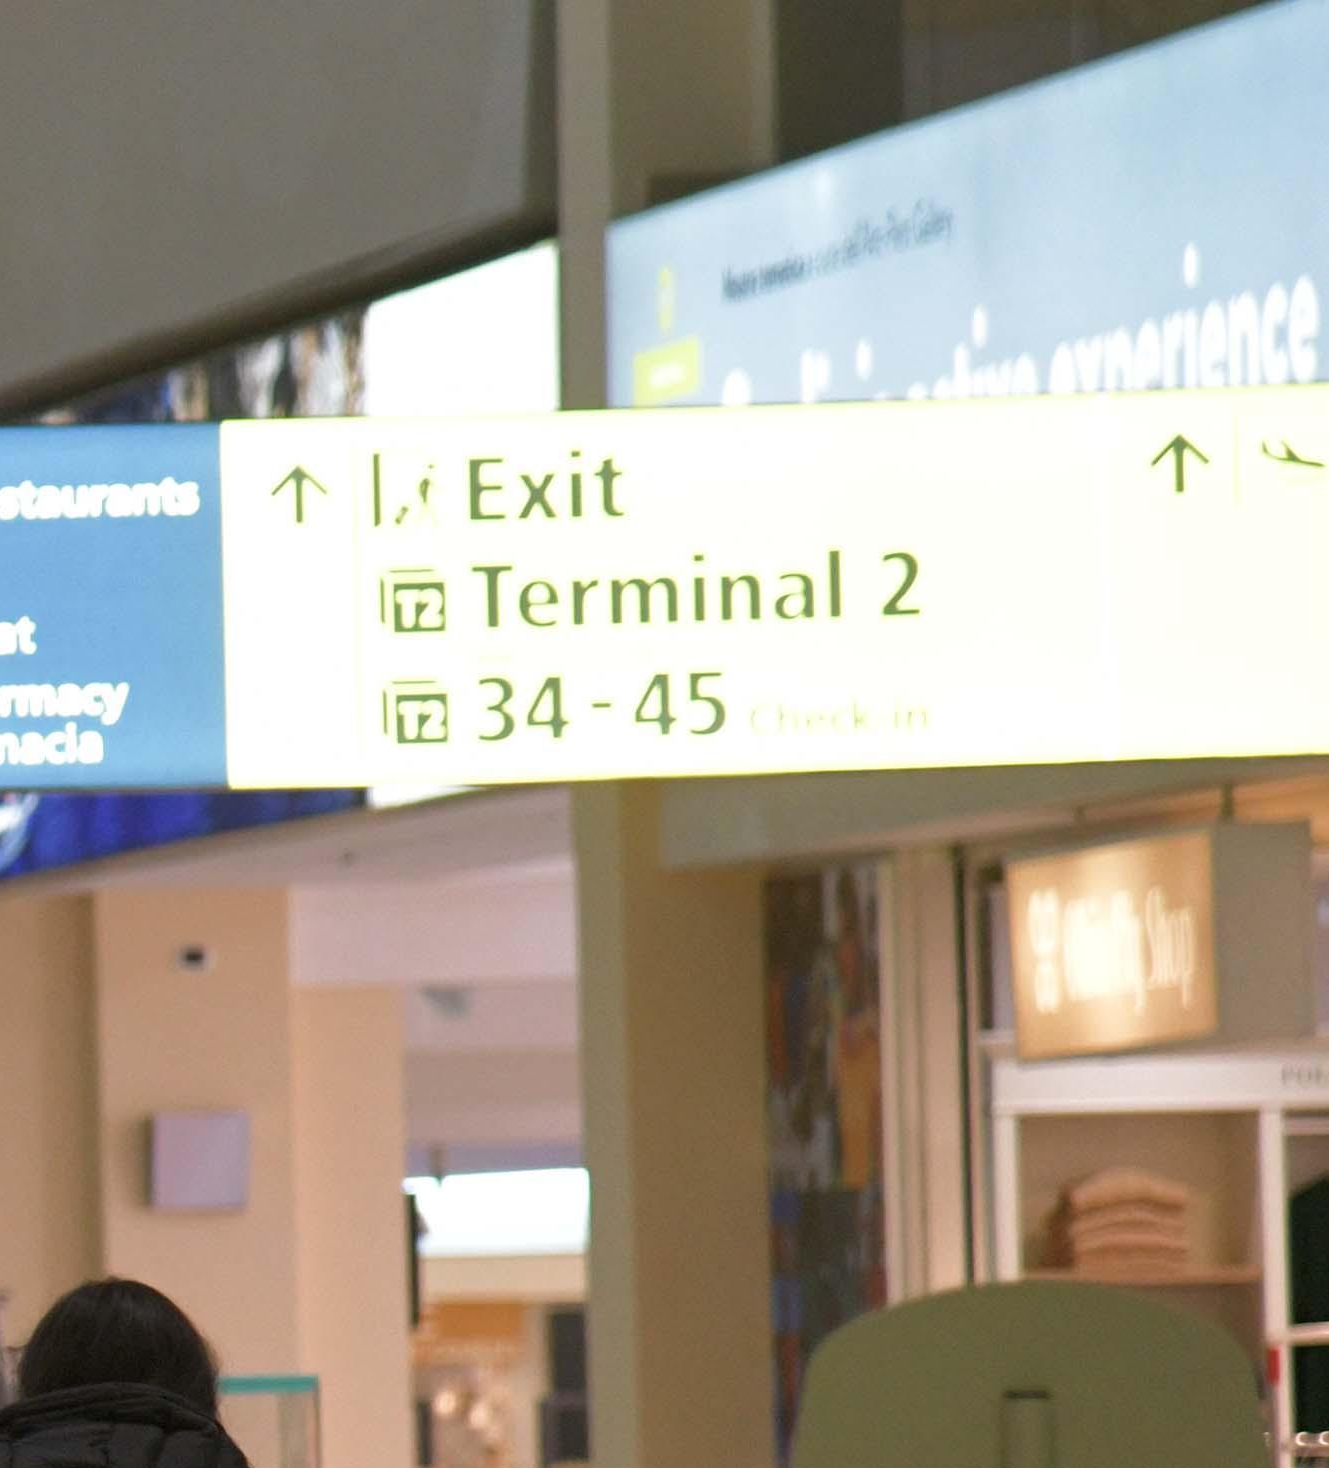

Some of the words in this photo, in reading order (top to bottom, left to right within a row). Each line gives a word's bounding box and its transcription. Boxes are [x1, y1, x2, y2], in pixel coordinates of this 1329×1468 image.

[468, 451, 625, 521] Exit
[472, 547, 843, 630] Terminal
[881, 549, 923, 618] 2
[476, 670, 570, 743] 34
[632, 670, 729, 740] 45
